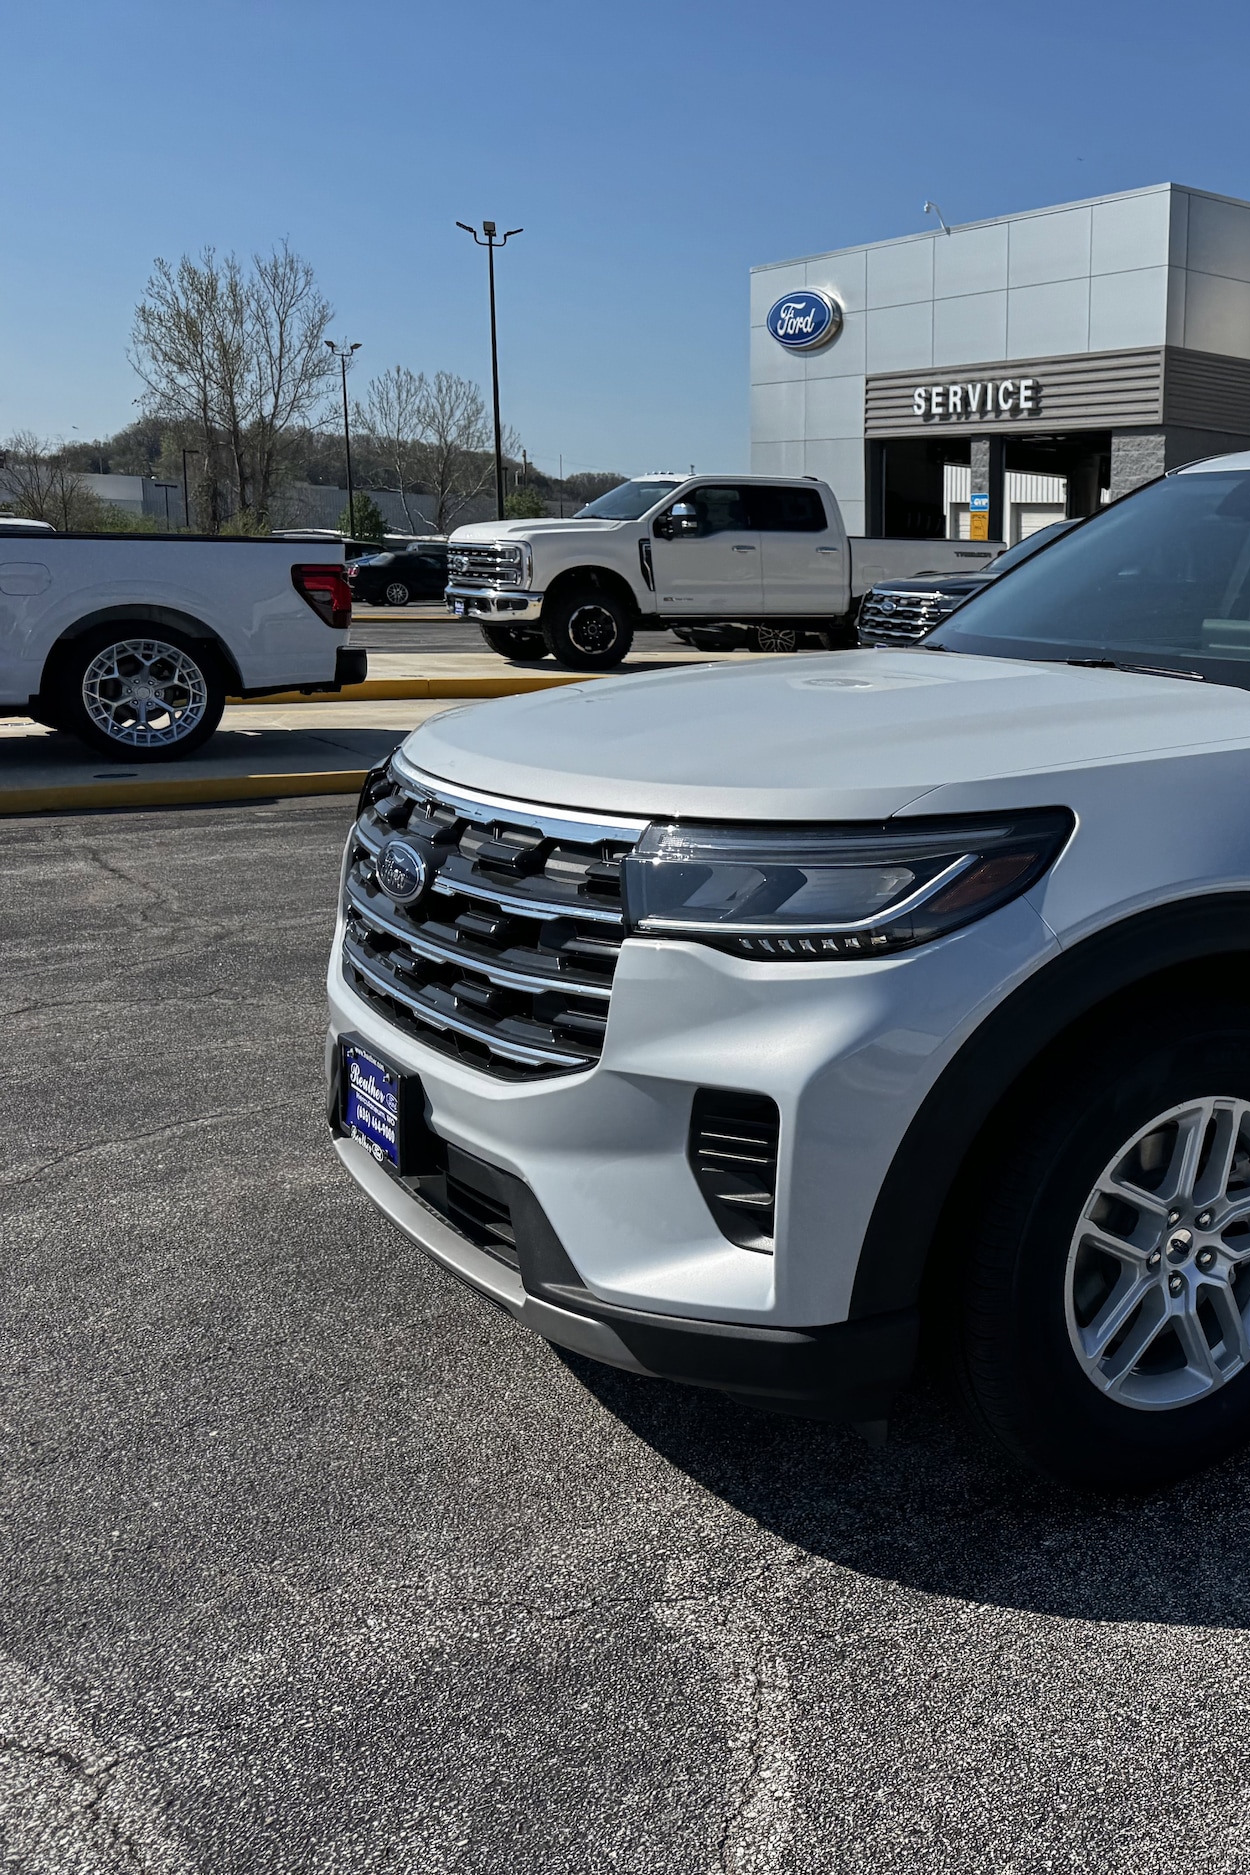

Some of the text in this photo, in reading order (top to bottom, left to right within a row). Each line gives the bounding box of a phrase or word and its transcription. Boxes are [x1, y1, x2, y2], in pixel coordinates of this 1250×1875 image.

[777, 302, 816, 336] Ford
[913, 379, 1034, 416] SERVICE
[350, 1062, 386, 1103] Reuther
